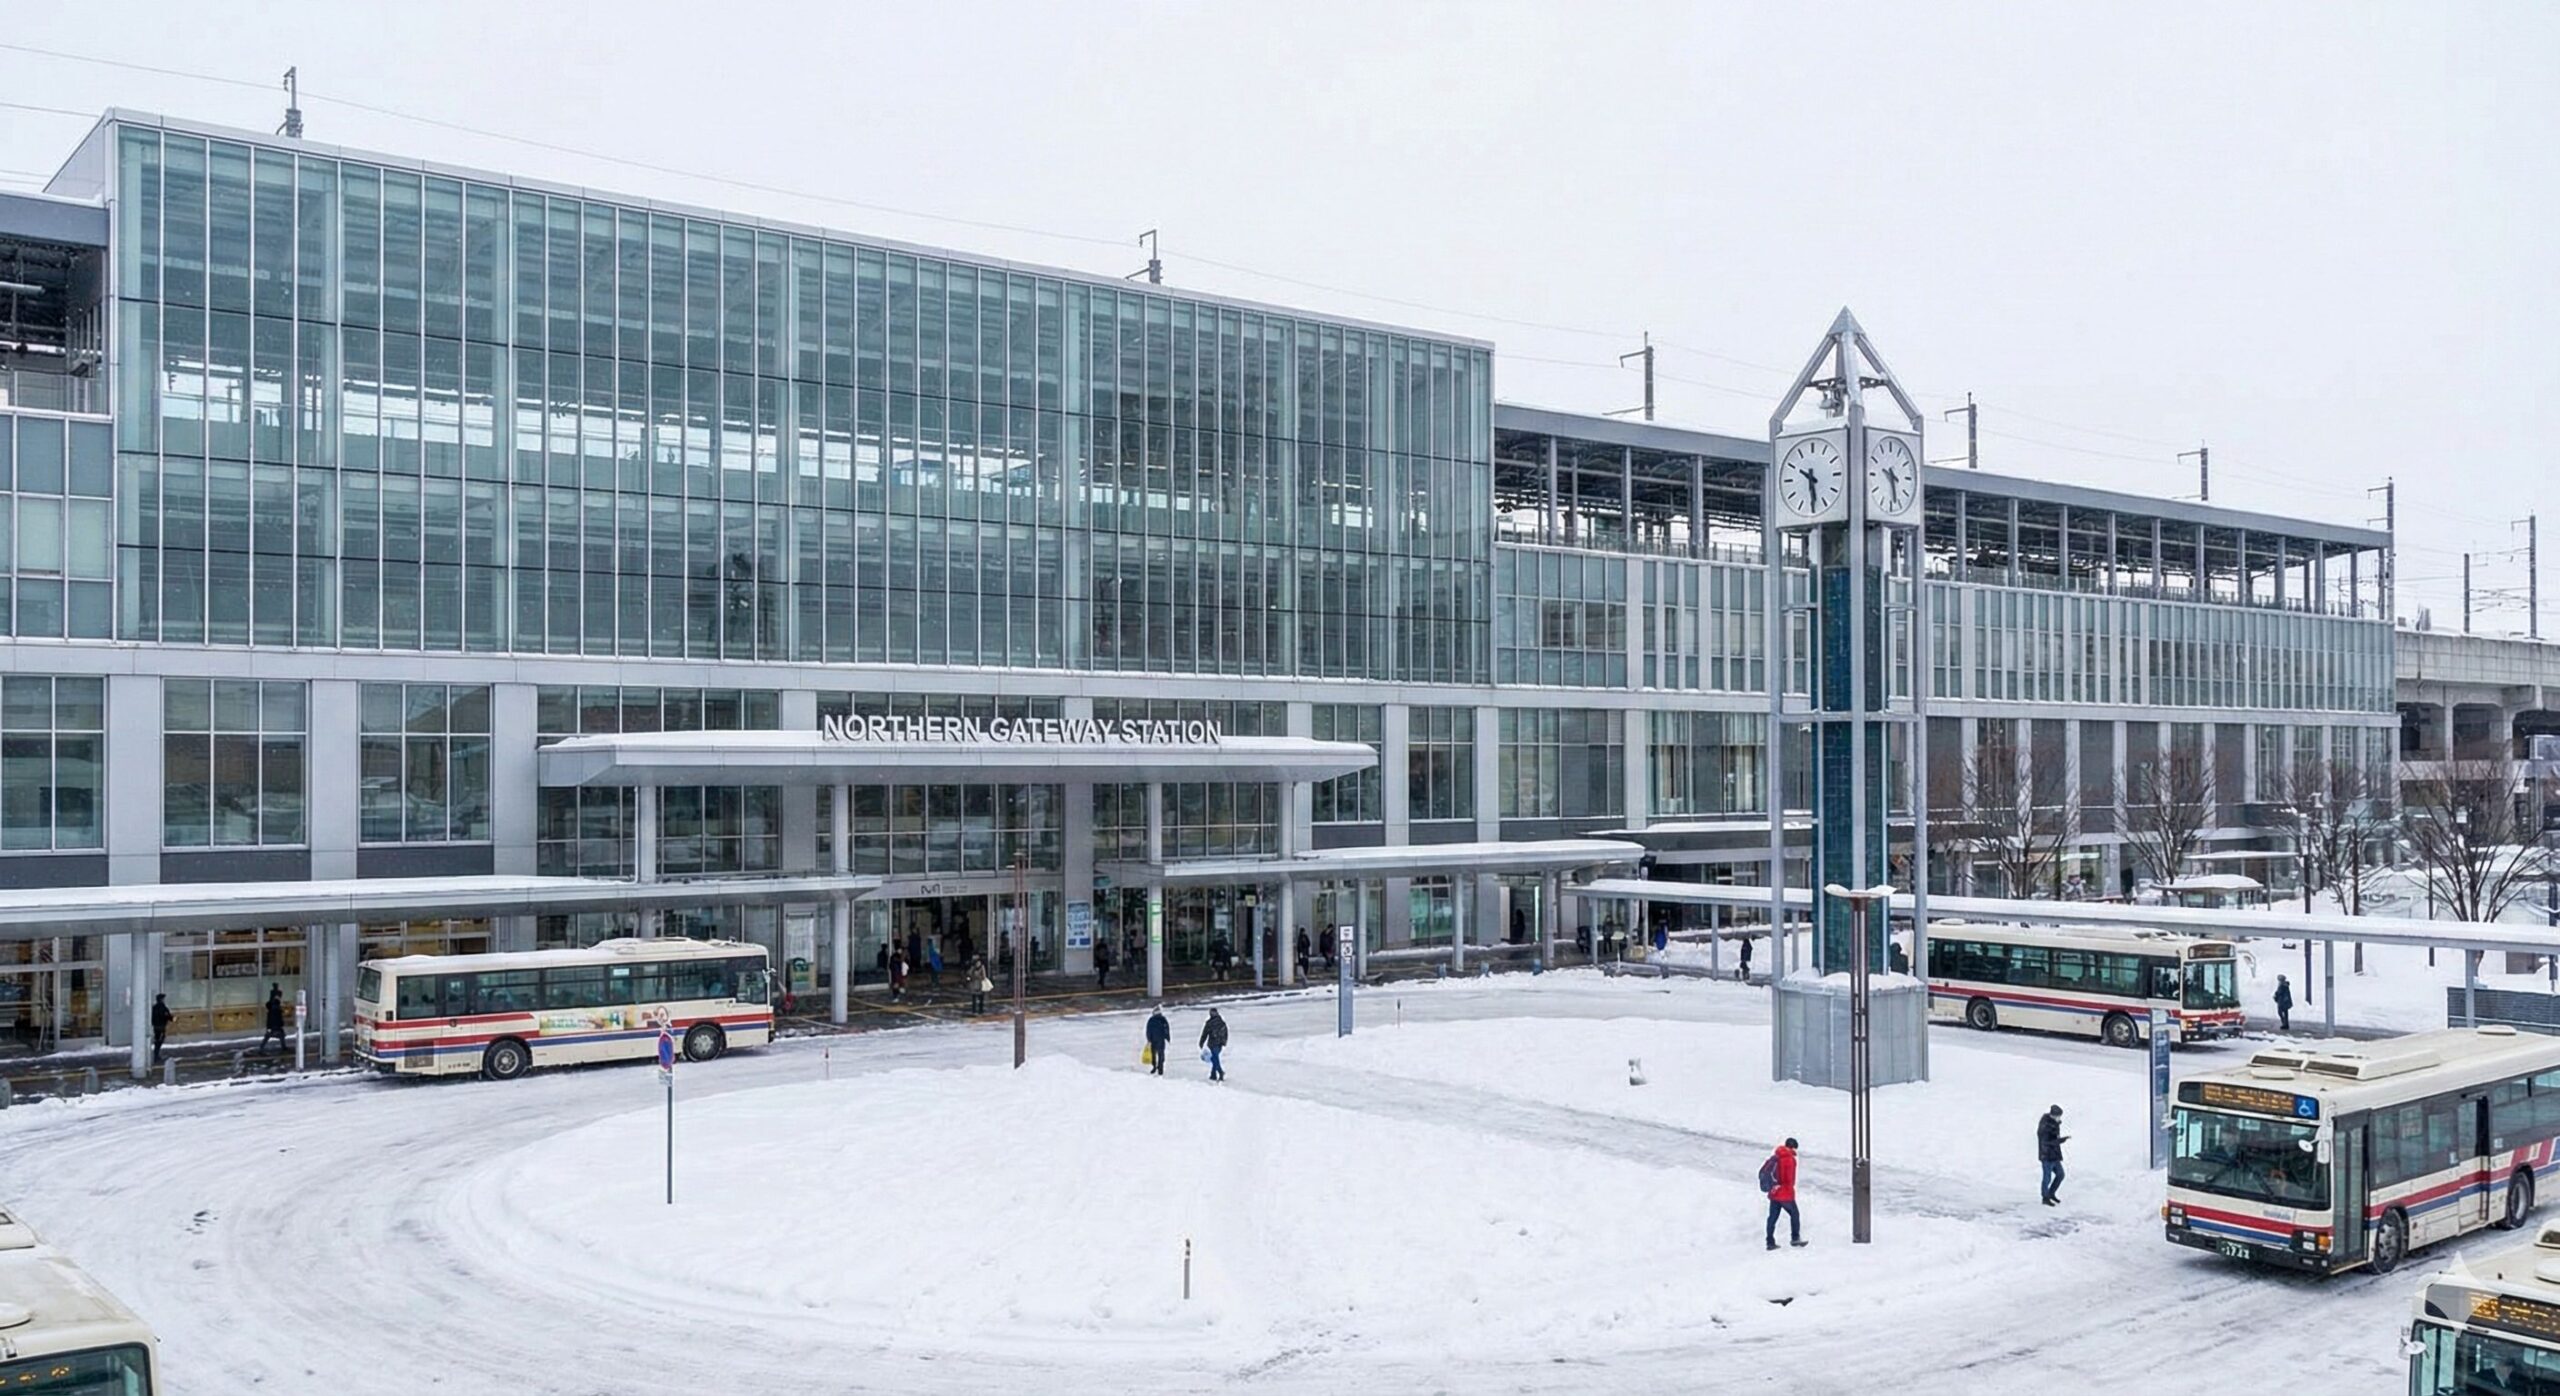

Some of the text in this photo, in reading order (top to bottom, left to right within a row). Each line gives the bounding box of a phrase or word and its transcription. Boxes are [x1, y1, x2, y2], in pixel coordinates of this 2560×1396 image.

[823, 714, 1221, 744] NORTHERN GATEWAY STATION
